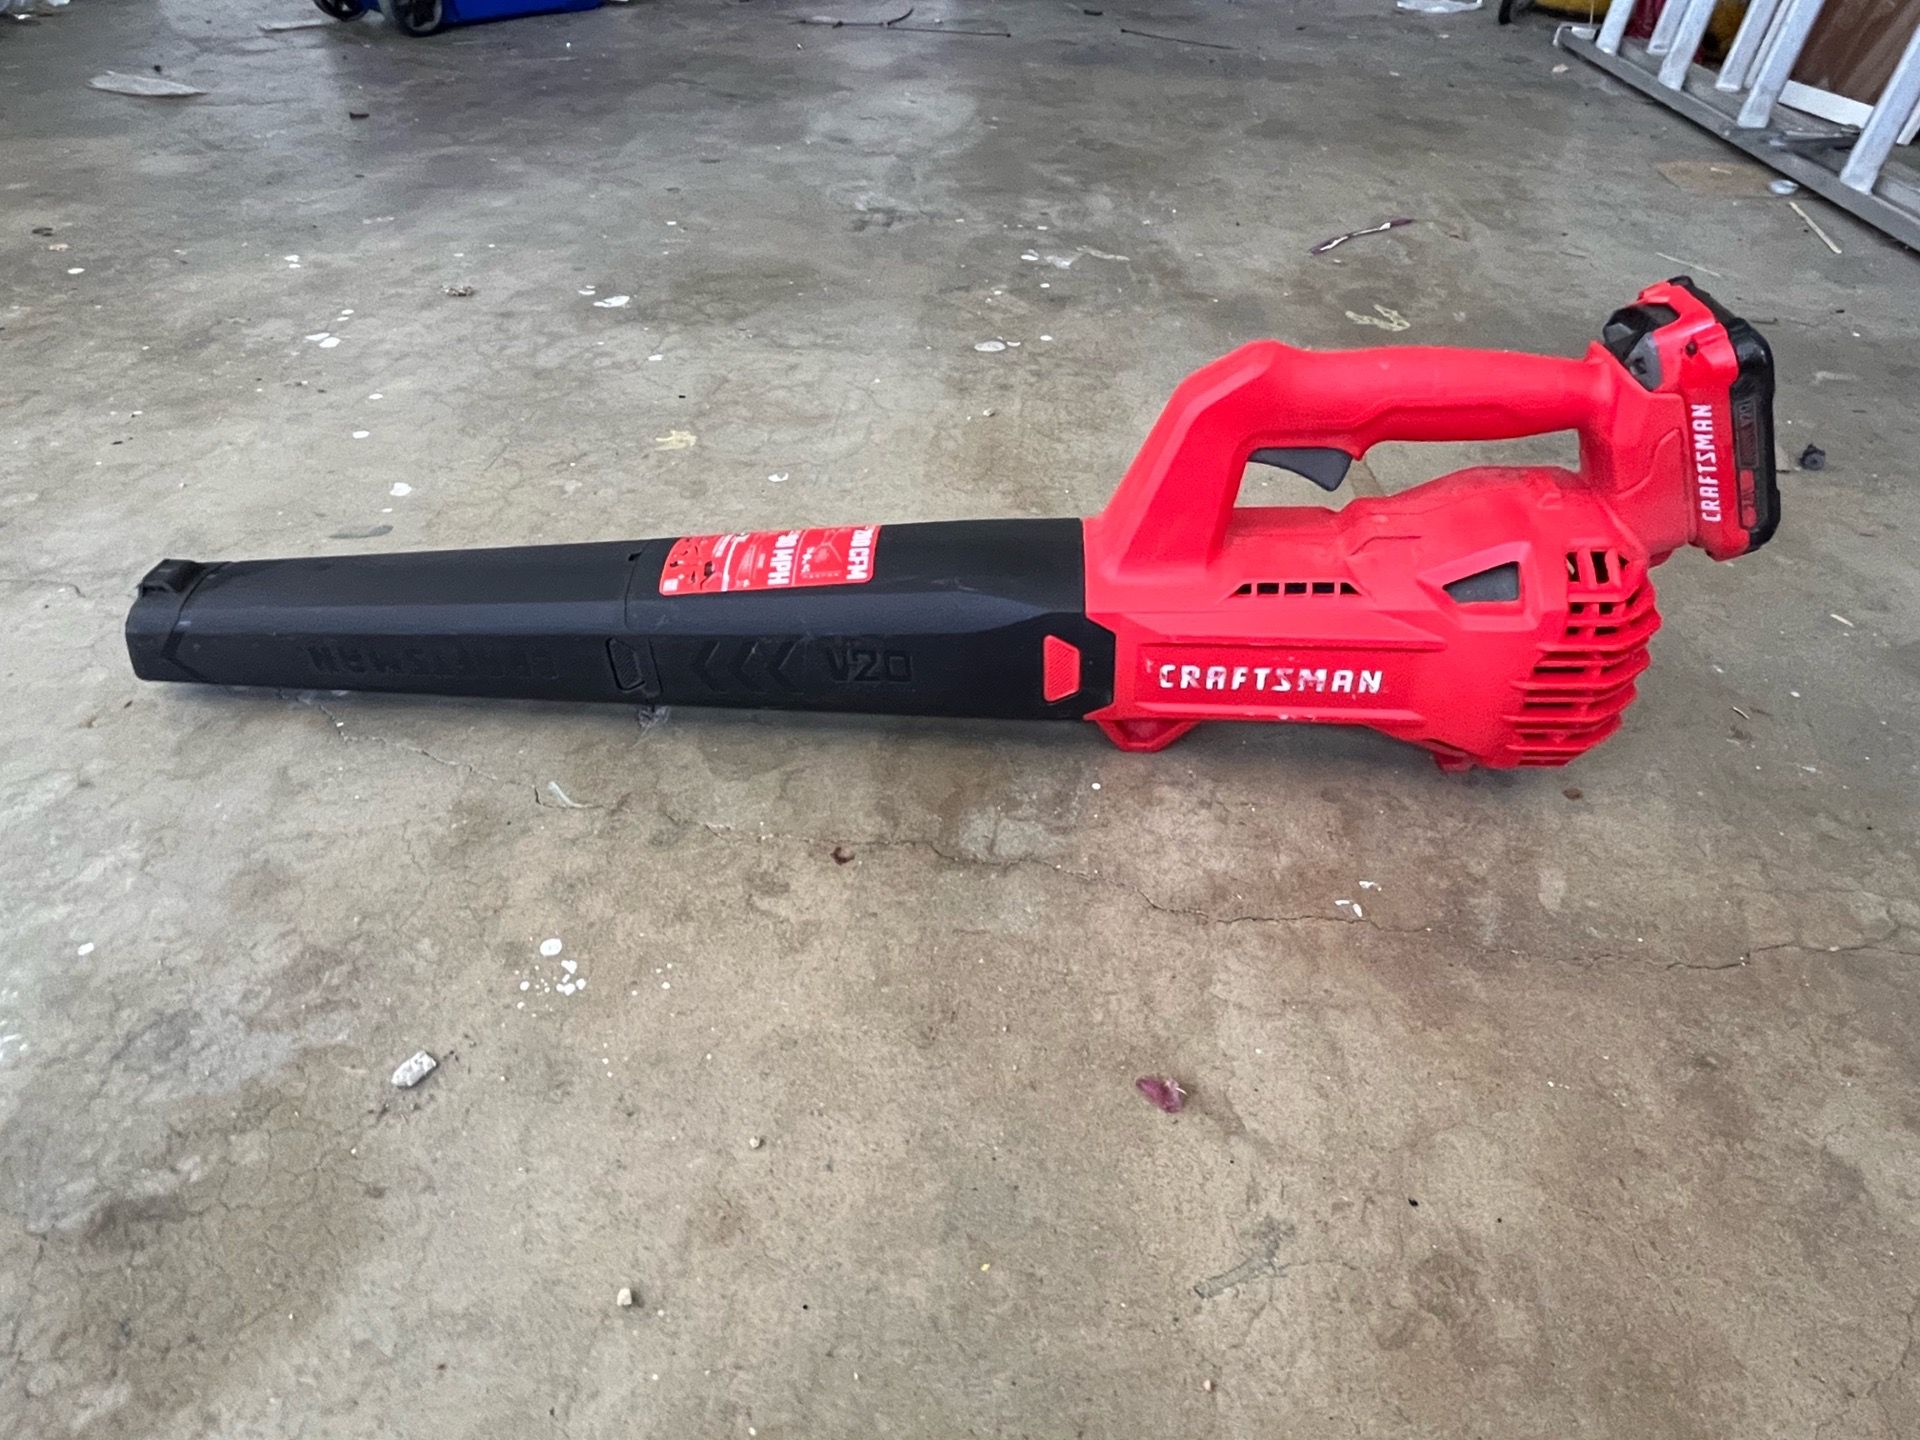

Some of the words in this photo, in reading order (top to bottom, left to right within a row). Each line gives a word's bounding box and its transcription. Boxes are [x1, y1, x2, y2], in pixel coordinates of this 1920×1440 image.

[1691, 404, 1721, 522] CRAFTSMAN
[767, 549, 794, 585] MPH
[846, 548, 869, 580] CFM
[826, 649, 914, 683] V20
[1158, 664, 1383, 694] CRAFTSMAN
